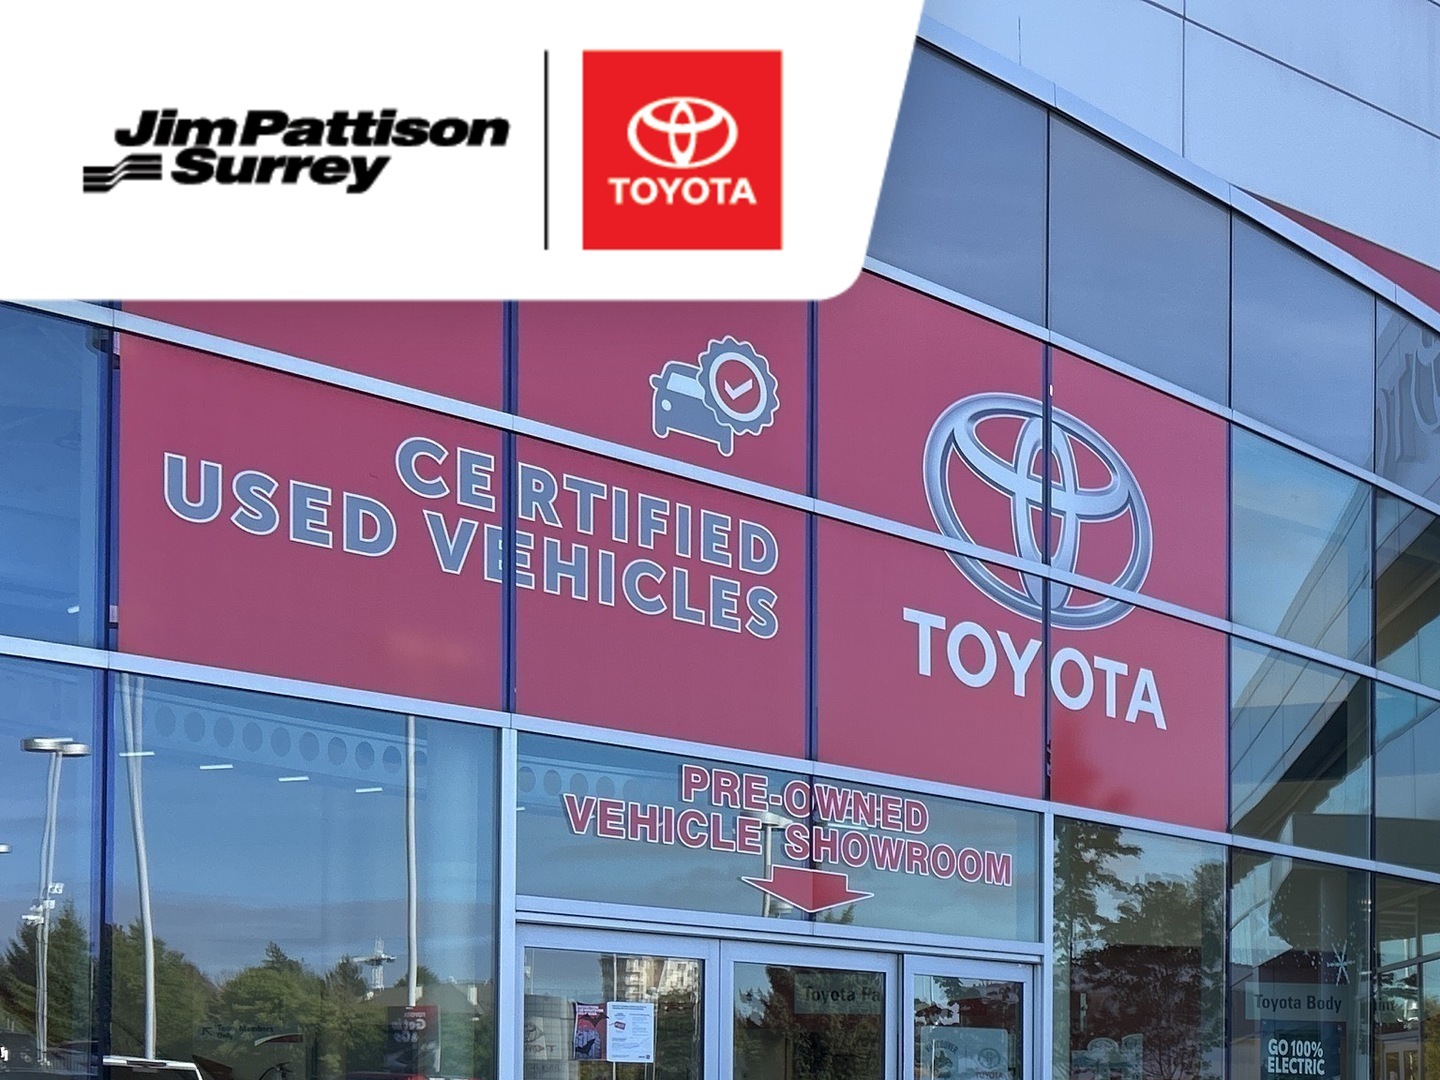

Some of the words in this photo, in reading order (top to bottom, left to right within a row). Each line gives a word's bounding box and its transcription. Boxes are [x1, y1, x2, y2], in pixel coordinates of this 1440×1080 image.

[395, 436, 779, 575] CERTIFIED
[163, 452, 397, 557] USED
[423, 509, 779, 639] VEHICLES
[903, 607, 1167, 730] TOYOTA
[680, 764, 930, 835] PRE-OWNED
[563, 793, 763, 854] VEHICLE
[784, 822, 1013, 886] SHOWROOM
[802, 986, 856, 1004] Toyota
[1254, 994, 1301, 1012] Toyota
[1307, 996, 1342, 1013] Body
[1267, 1057, 1326, 1075] ELECTRIC
[1268, 1039, 1288, 1056] GO
[1290, 1040, 1324, 1058] 100%
